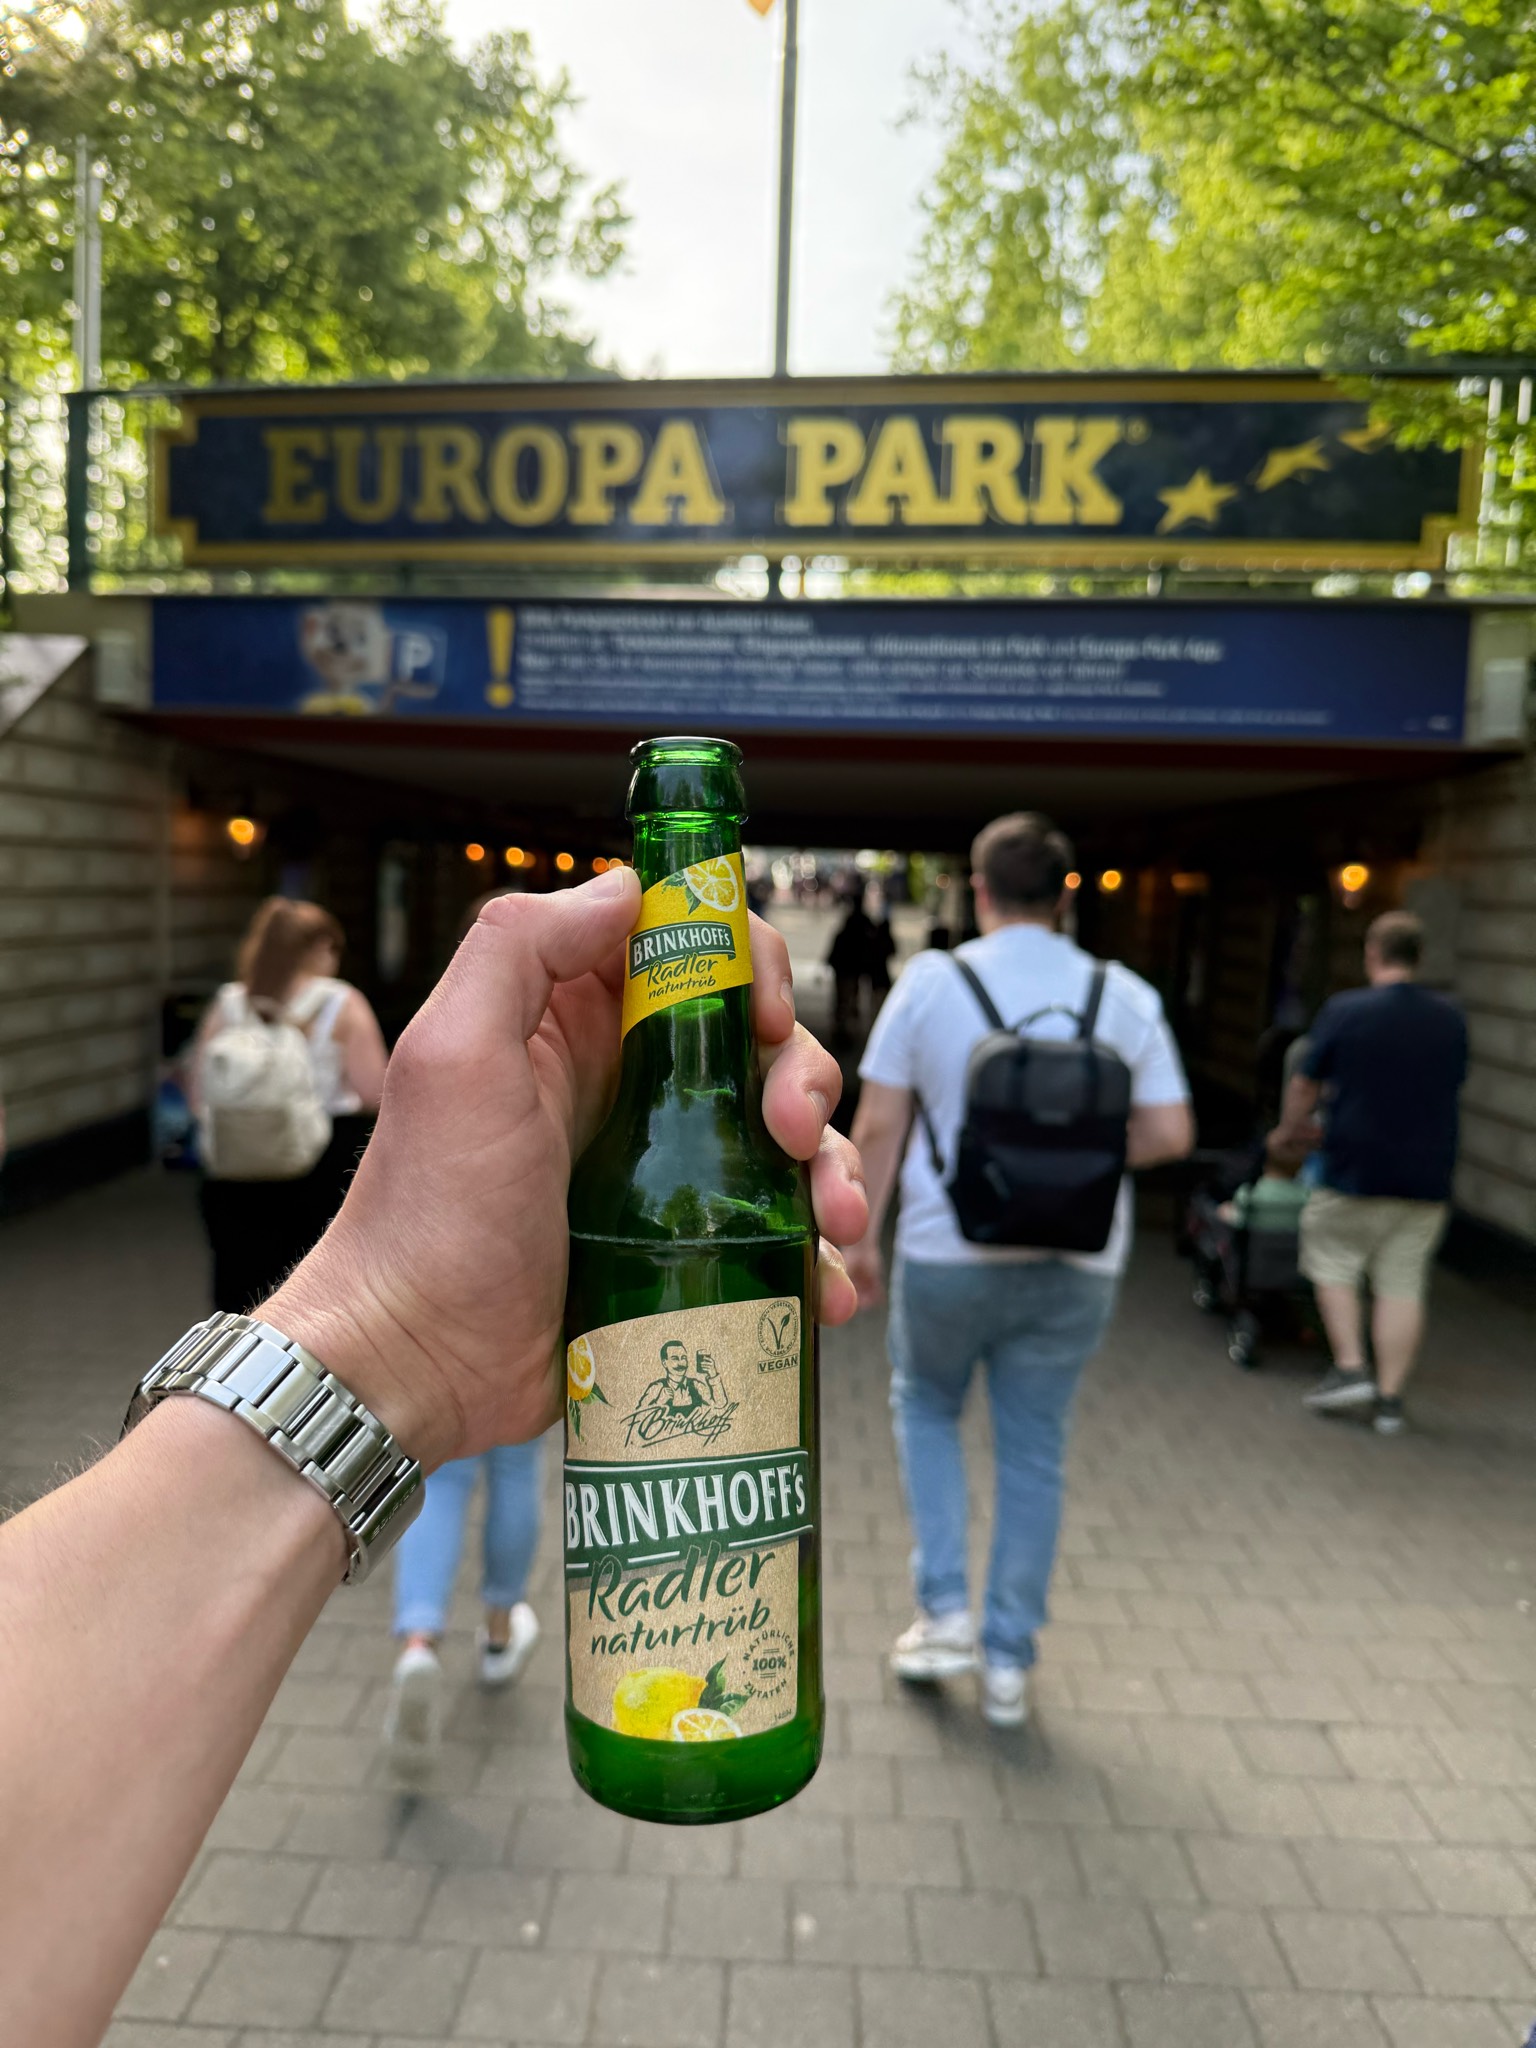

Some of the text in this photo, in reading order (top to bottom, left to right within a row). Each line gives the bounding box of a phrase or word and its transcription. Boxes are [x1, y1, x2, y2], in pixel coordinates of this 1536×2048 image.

[261, 419, 727, 526] EUROPA
[633, 927, 731, 967] BRINKHOFF's
[647, 952, 718, 987] Radler
[648, 975, 717, 1000] naturtrüb
[758, 1355, 798, 1372] VEGAN
[565, 1463, 806, 1549] BRINKHOFF's
[588, 1540, 775, 1622] Radler
[591, 1598, 770, 1656] naturtrüb
[743, 1629, 795, 1661] NATÜRLICHE
[752, 1655, 787, 1671] 100%
[744, 1679, 787, 1699] ZUTATEN
